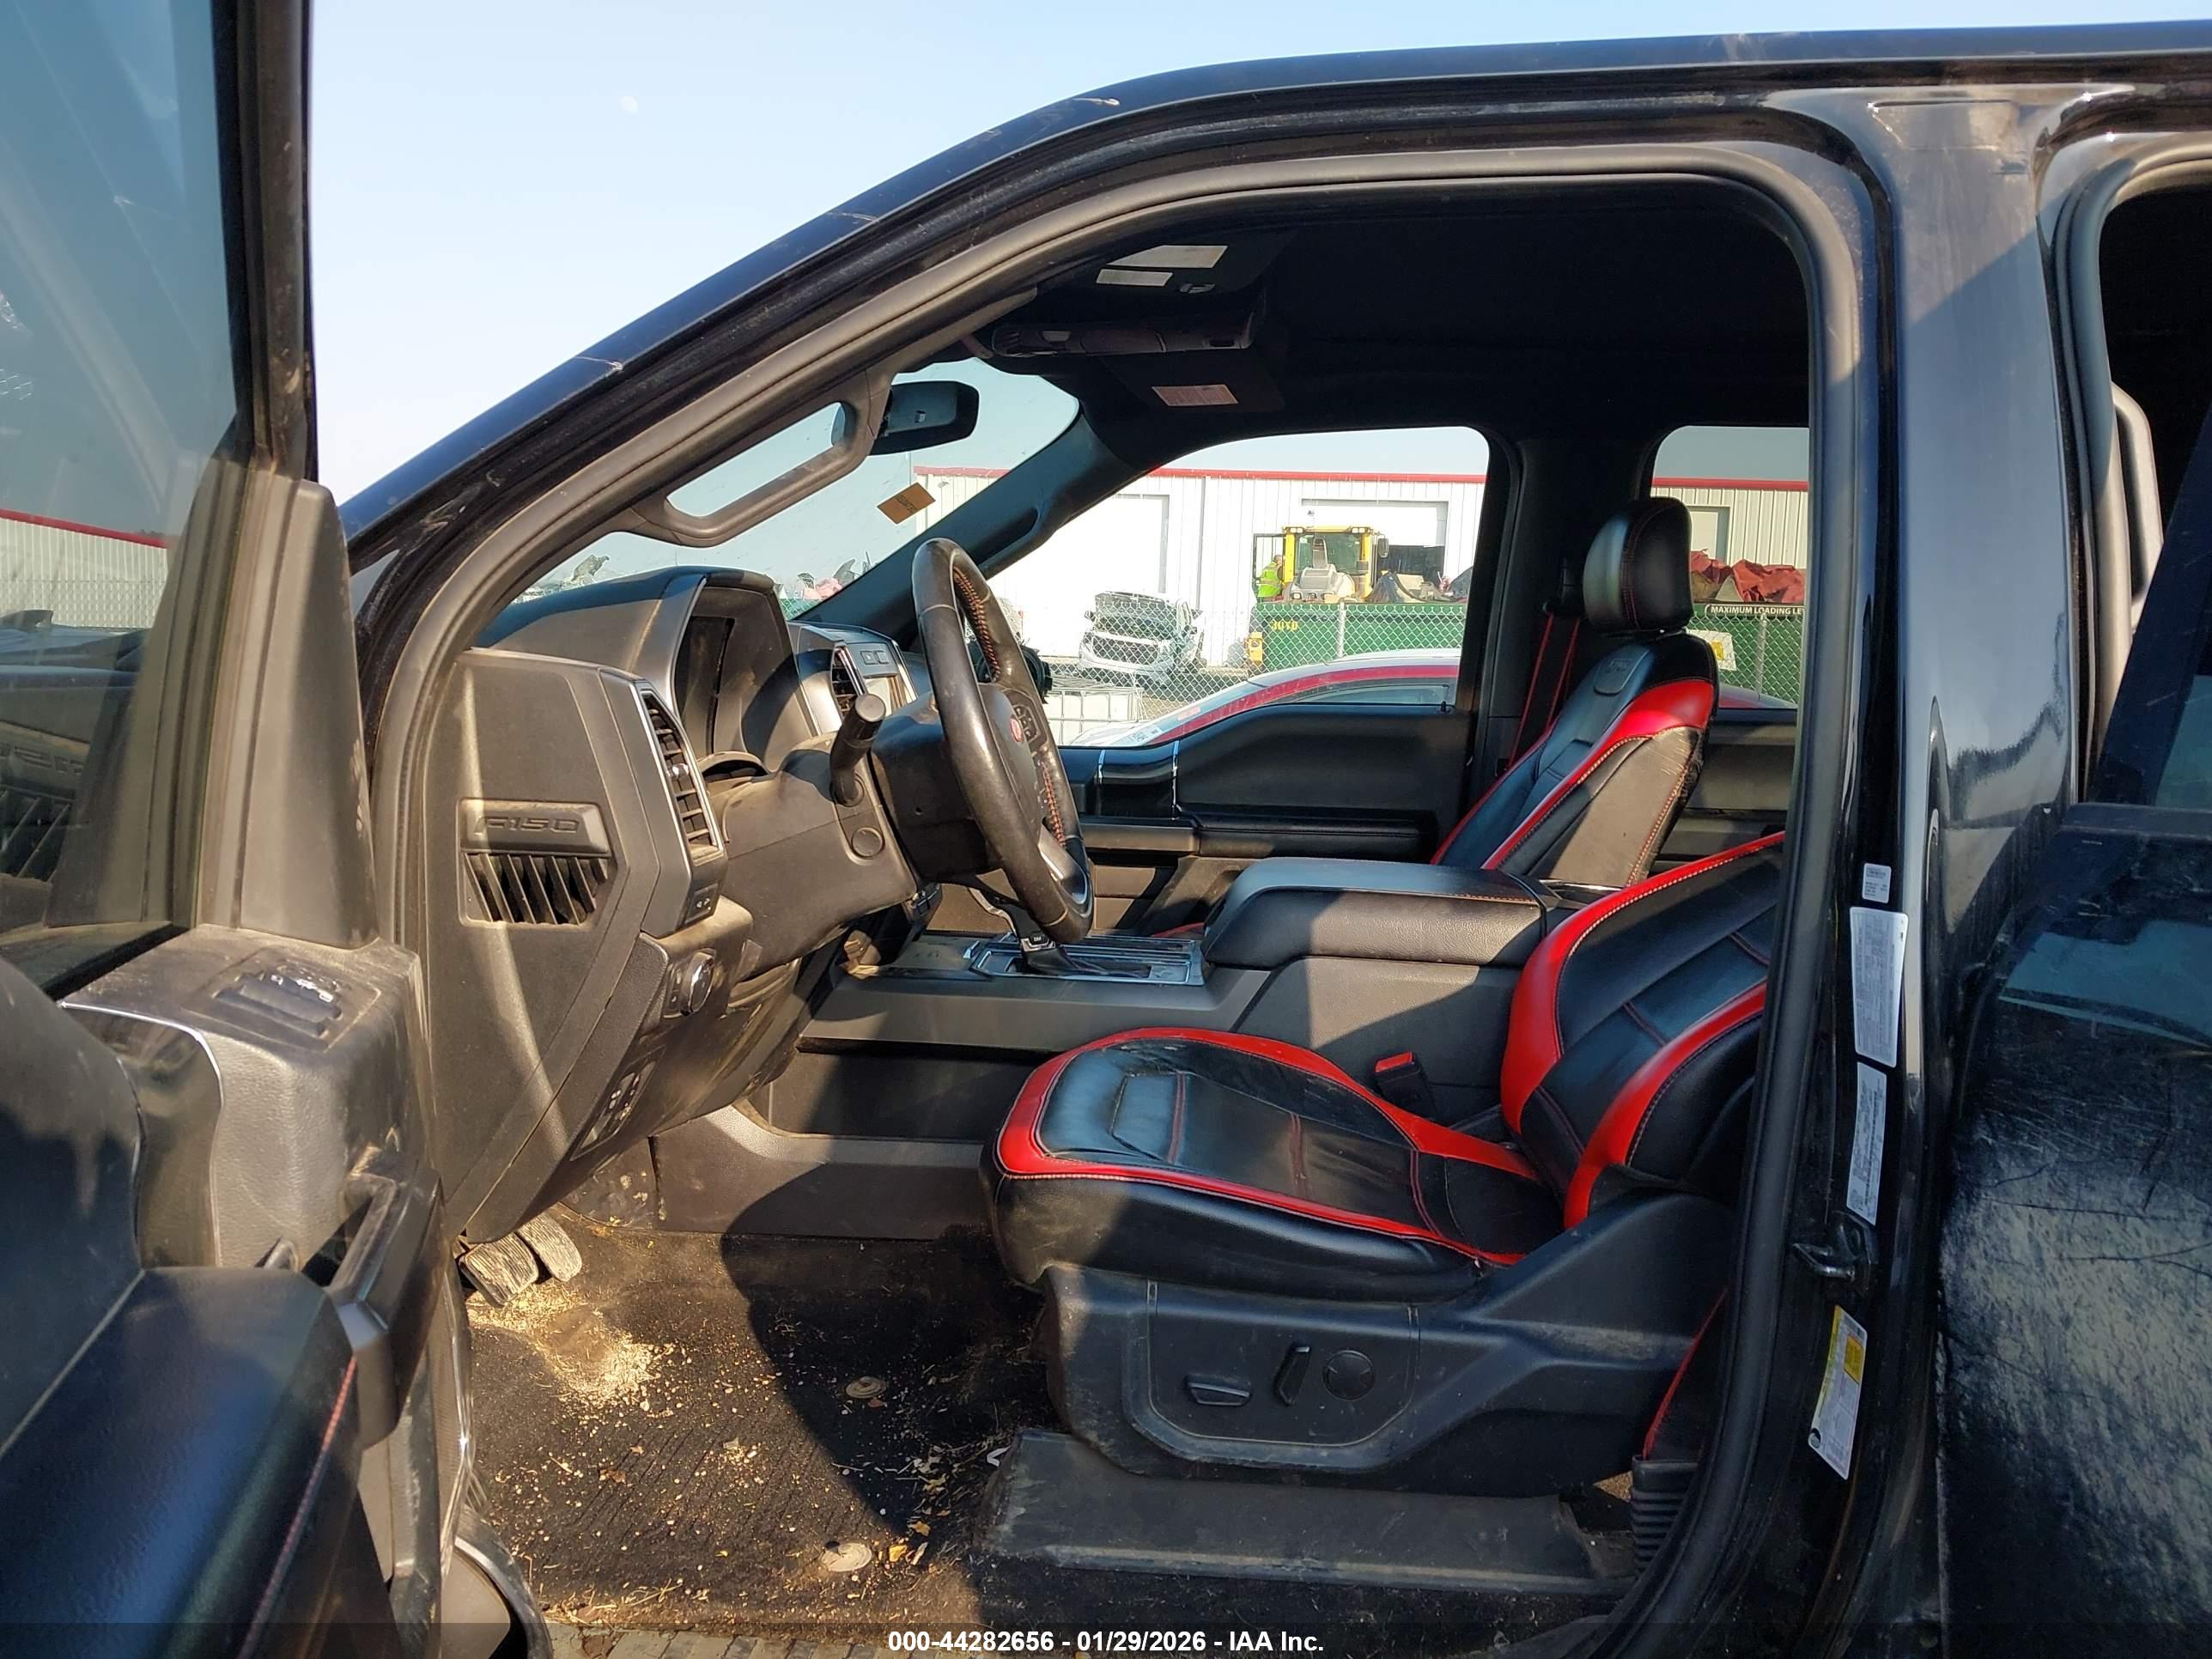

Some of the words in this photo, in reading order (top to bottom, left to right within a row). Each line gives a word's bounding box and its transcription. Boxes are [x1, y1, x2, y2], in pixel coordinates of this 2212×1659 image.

[1711, 605, 1753, 614] MAXIMUM
[1753, 606, 1791, 615] LOADING
[473, 816, 580, 836] F150
